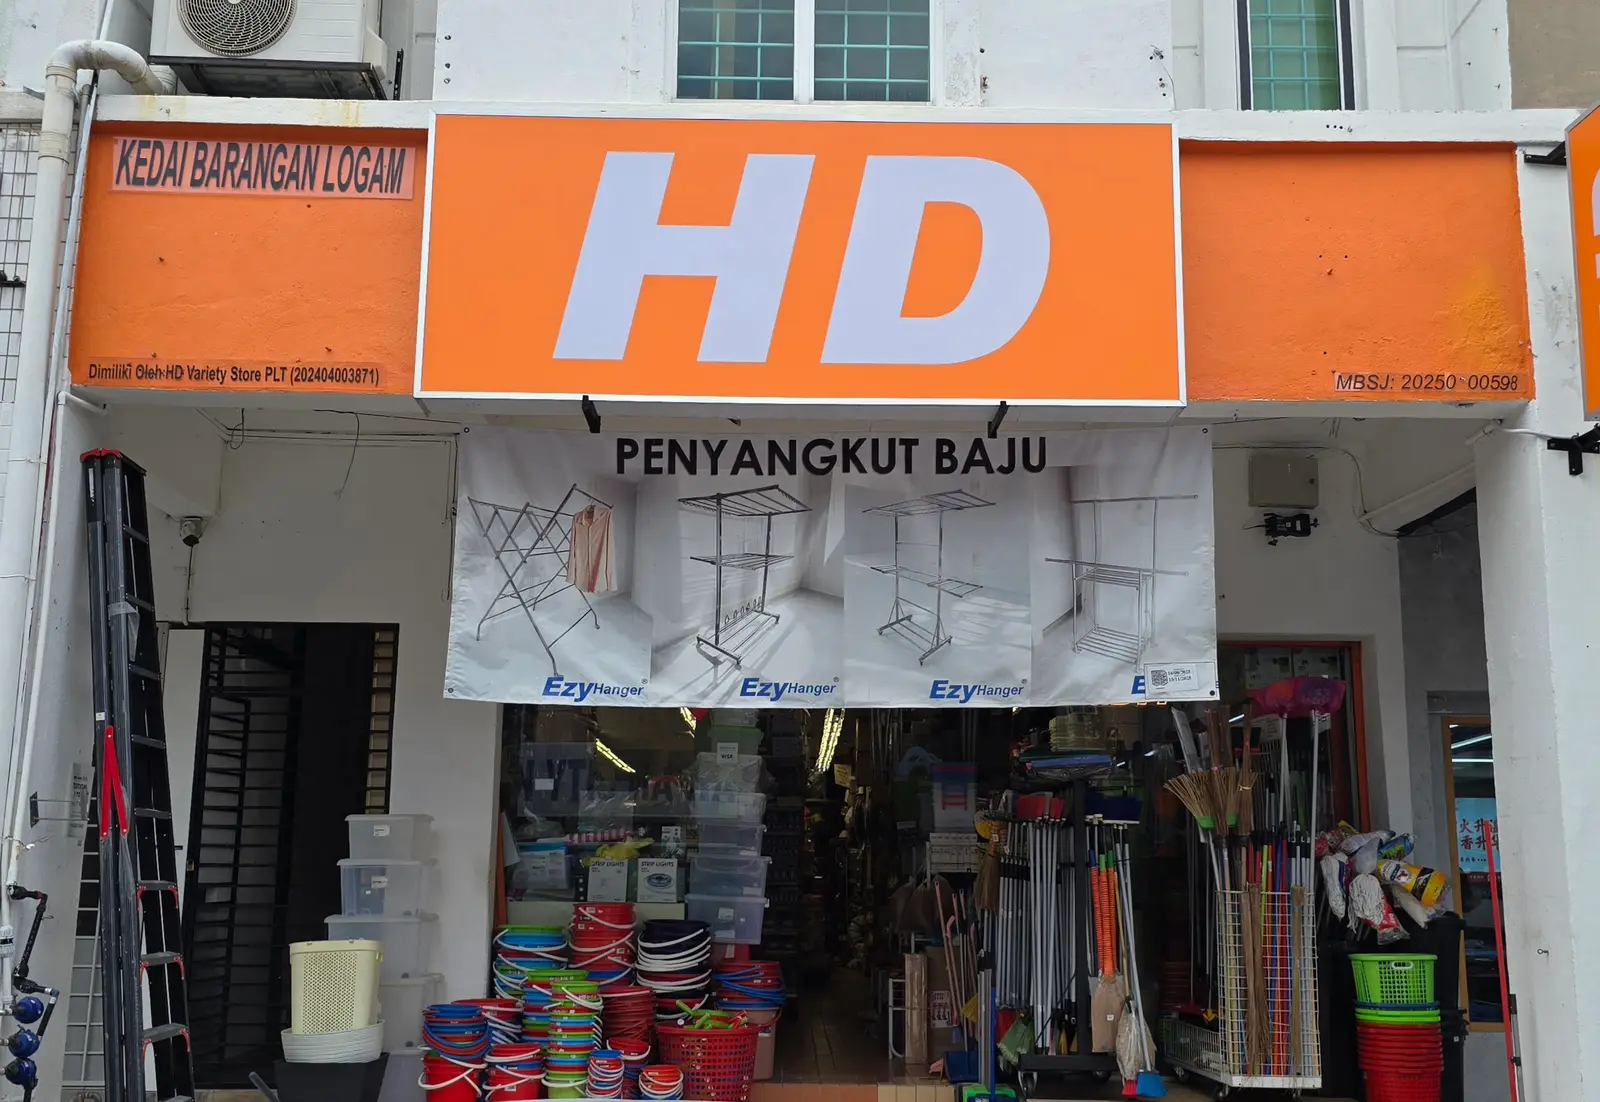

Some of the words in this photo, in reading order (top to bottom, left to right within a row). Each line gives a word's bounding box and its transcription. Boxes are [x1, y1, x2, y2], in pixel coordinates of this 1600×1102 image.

[115, 139, 188, 187] KEDAI
[189, 141, 320, 191] BARANGAN
[322, 145, 406, 194] LOGAM
[553, 151, 1050, 365] HD
[88, 363, 132, 379] Dimiliki
[135, 364, 163, 380] Oleh
[165, 365, 184, 380] HD
[186, 365, 227, 385] Variety
[230, 366, 261, 383] Store
[265, 366, 287, 383] PLT
[290, 367, 380, 387] (202404003871)
[1335, 373, 1395, 390] MBSJ:
[616, 438, 919, 476] PENYANGKUT
[935, 437, 1047, 475] BAJU
